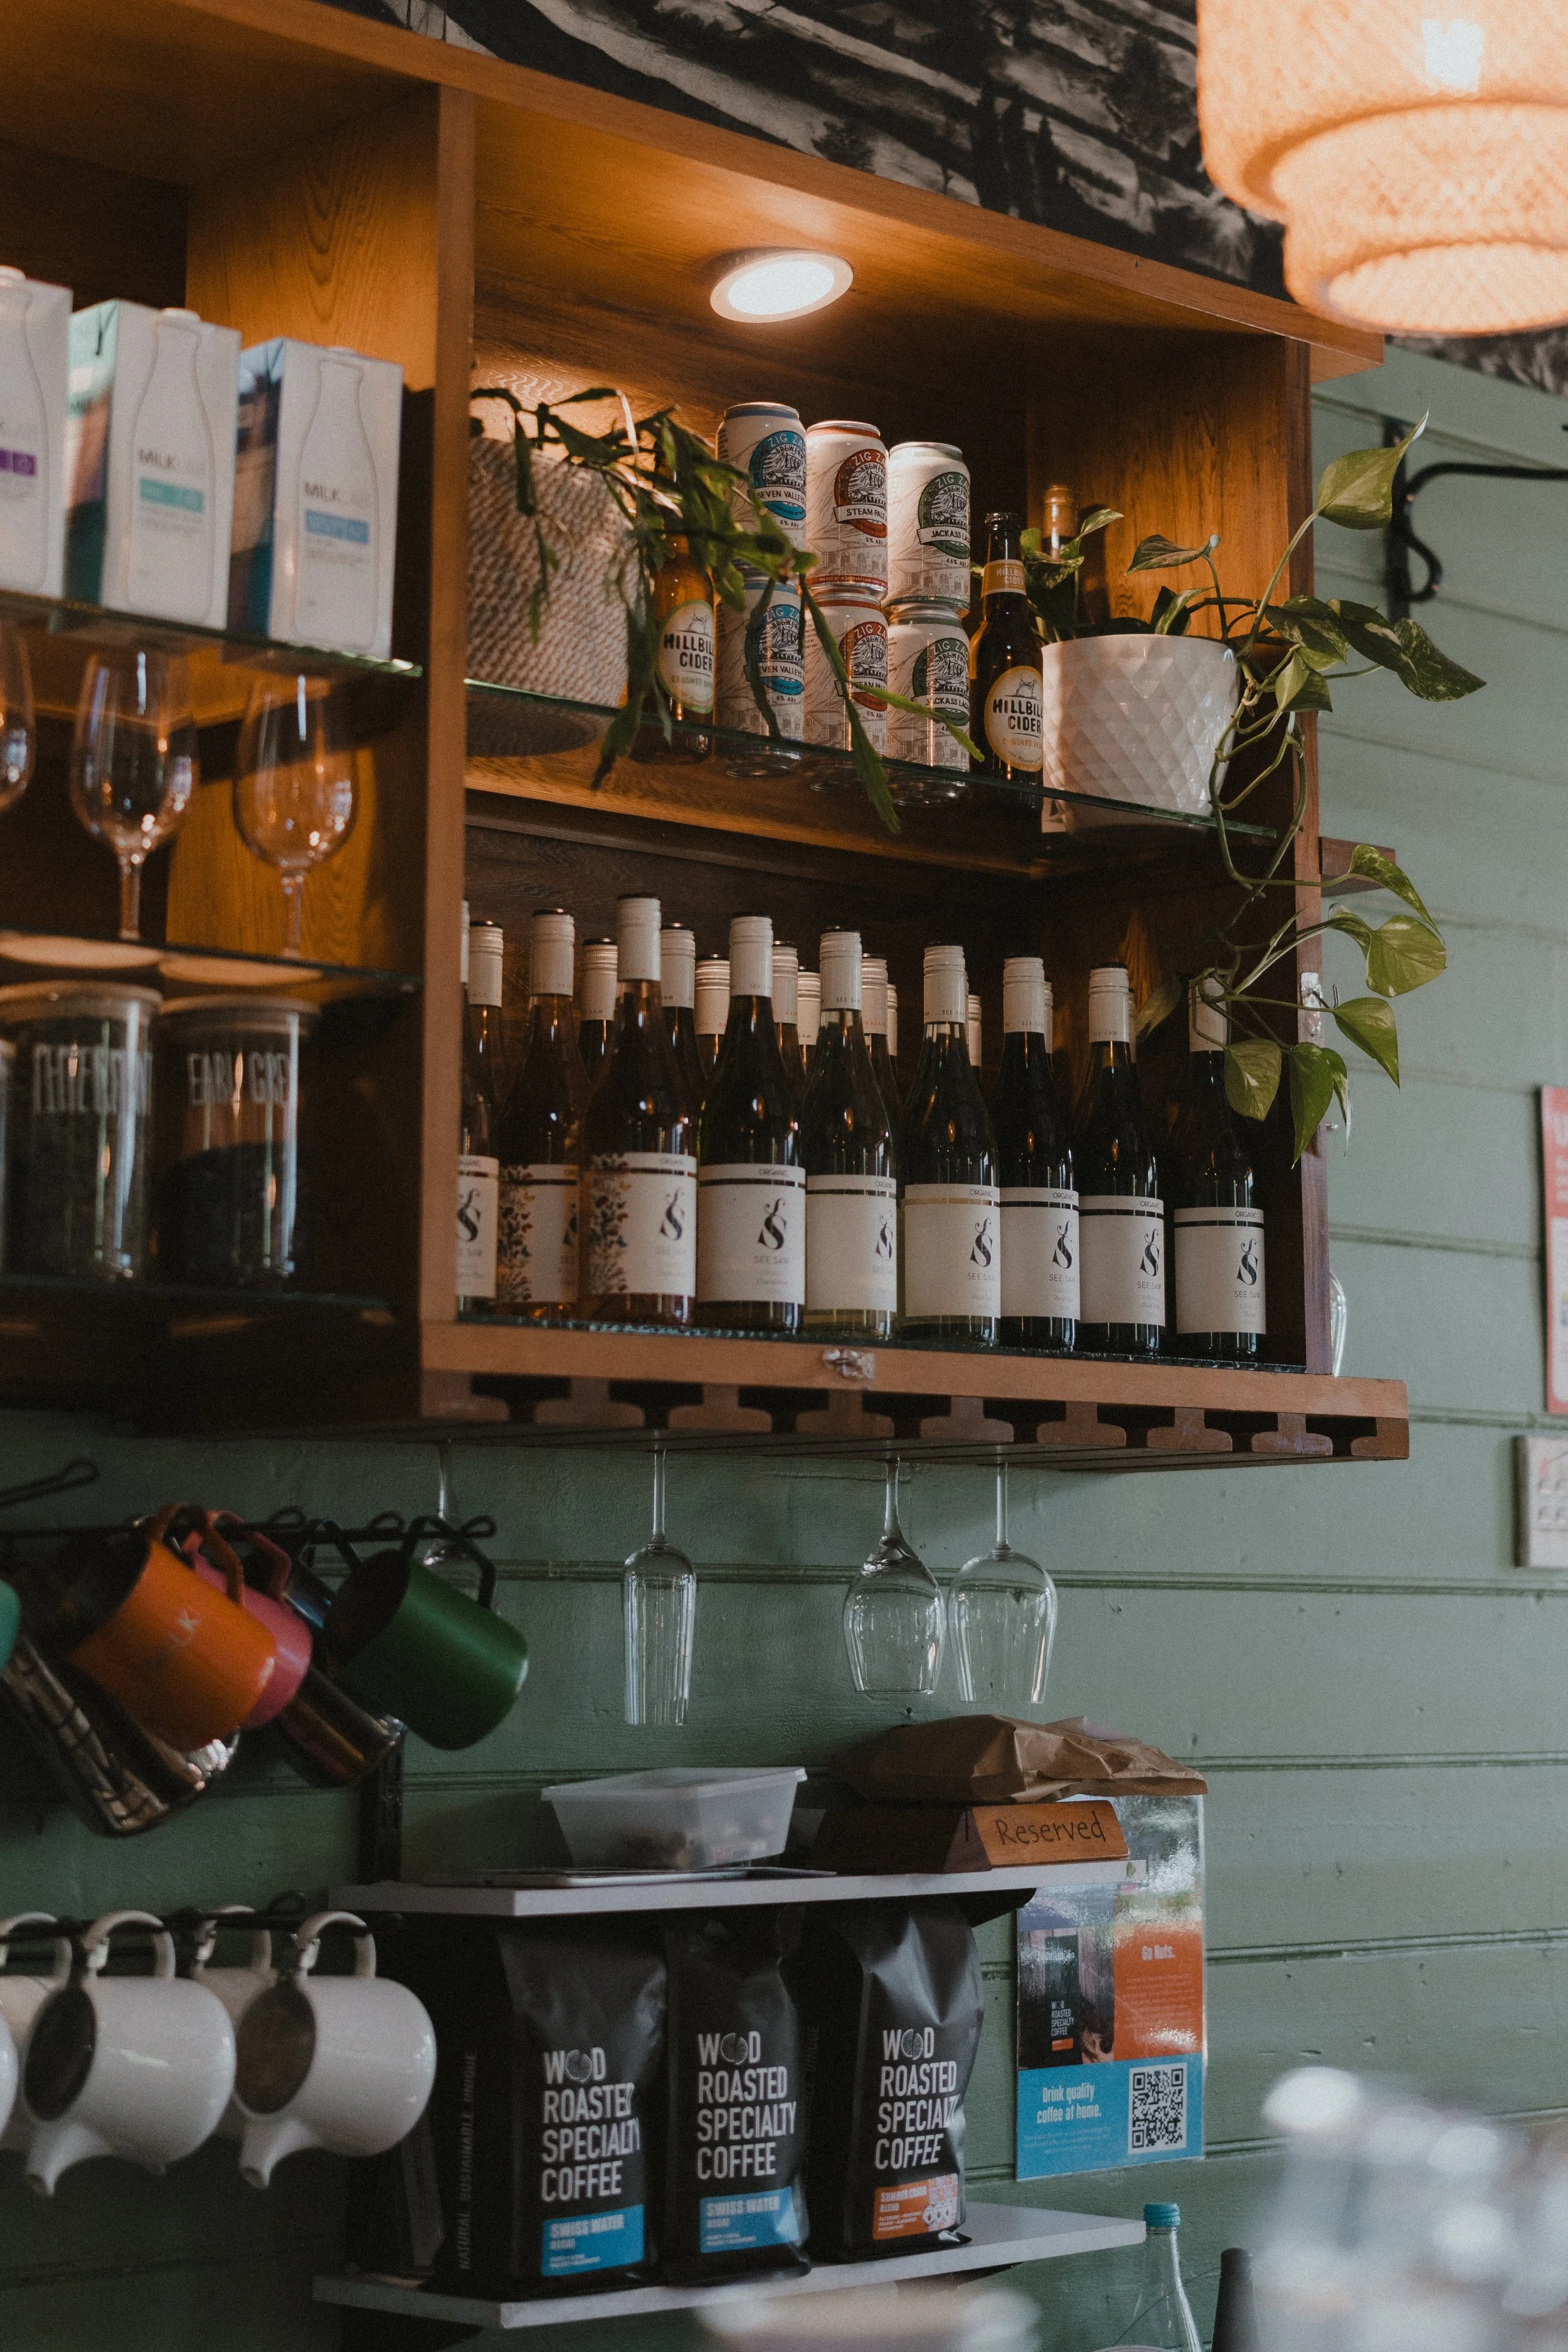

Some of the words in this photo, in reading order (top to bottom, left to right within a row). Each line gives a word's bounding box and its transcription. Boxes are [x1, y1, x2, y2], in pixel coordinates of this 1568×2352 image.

[767, 433, 788, 448] ZIG
[852, 452, 872, 466] ZIG
[935, 474, 955, 489] ZIG
[757, 490, 782, 500] SEVEN
[846, 508, 873, 517] STEAM
[874, 509, 885, 520] PALE
[931, 529, 961, 539] JACKASS
[763, 607, 784, 622] ZIG
[854, 624, 873, 638] ZIG
[930, 641, 950, 655] ZIG
[679, 651, 712, 673] CIDER
[1007, 715, 1041, 734] CIDER
[970, 1189, 994, 1197] ORGANIC
[1052, 1192, 1074, 1200] ORGANIC
[1140, 1200, 1160, 1209] ORGANIC
[1235, 1210, 1258, 1219] ORGANIC
[967, 1273, 982, 1281] SEE
[1049, 1274, 1063, 1282] SEE
[1137, 1281, 1150, 1290] SEE
[1234, 1290, 1248, 1298] SEE
[995, 1810, 1106, 1846] Reserved
[1051, 2008, 1071, 2018] ROASTED
[1051, 2017, 1074, 2028] SPECIALTY
[1051, 2026, 1068, 2037] COFFEE
[698, 2066, 788, 2104] ROASTED
[881, 2060, 957, 2097] ROASTED
[1042, 2084, 1064, 2103] Drink
[1066, 2082, 1094, 2104] quality
[1037, 2106, 1064, 2124] coffee
[1066, 2104, 1074, 2121] at
[1076, 2103, 1102, 2119] home.
[697, 2100, 797, 2142] SPECIALTY
[875, 2133, 944, 2170] COFFEE
[697, 2141, 776, 2181] COFFEE
[541, 2160, 623, 2203] COFFEE
[706, 2200, 744, 2217] SWISS
